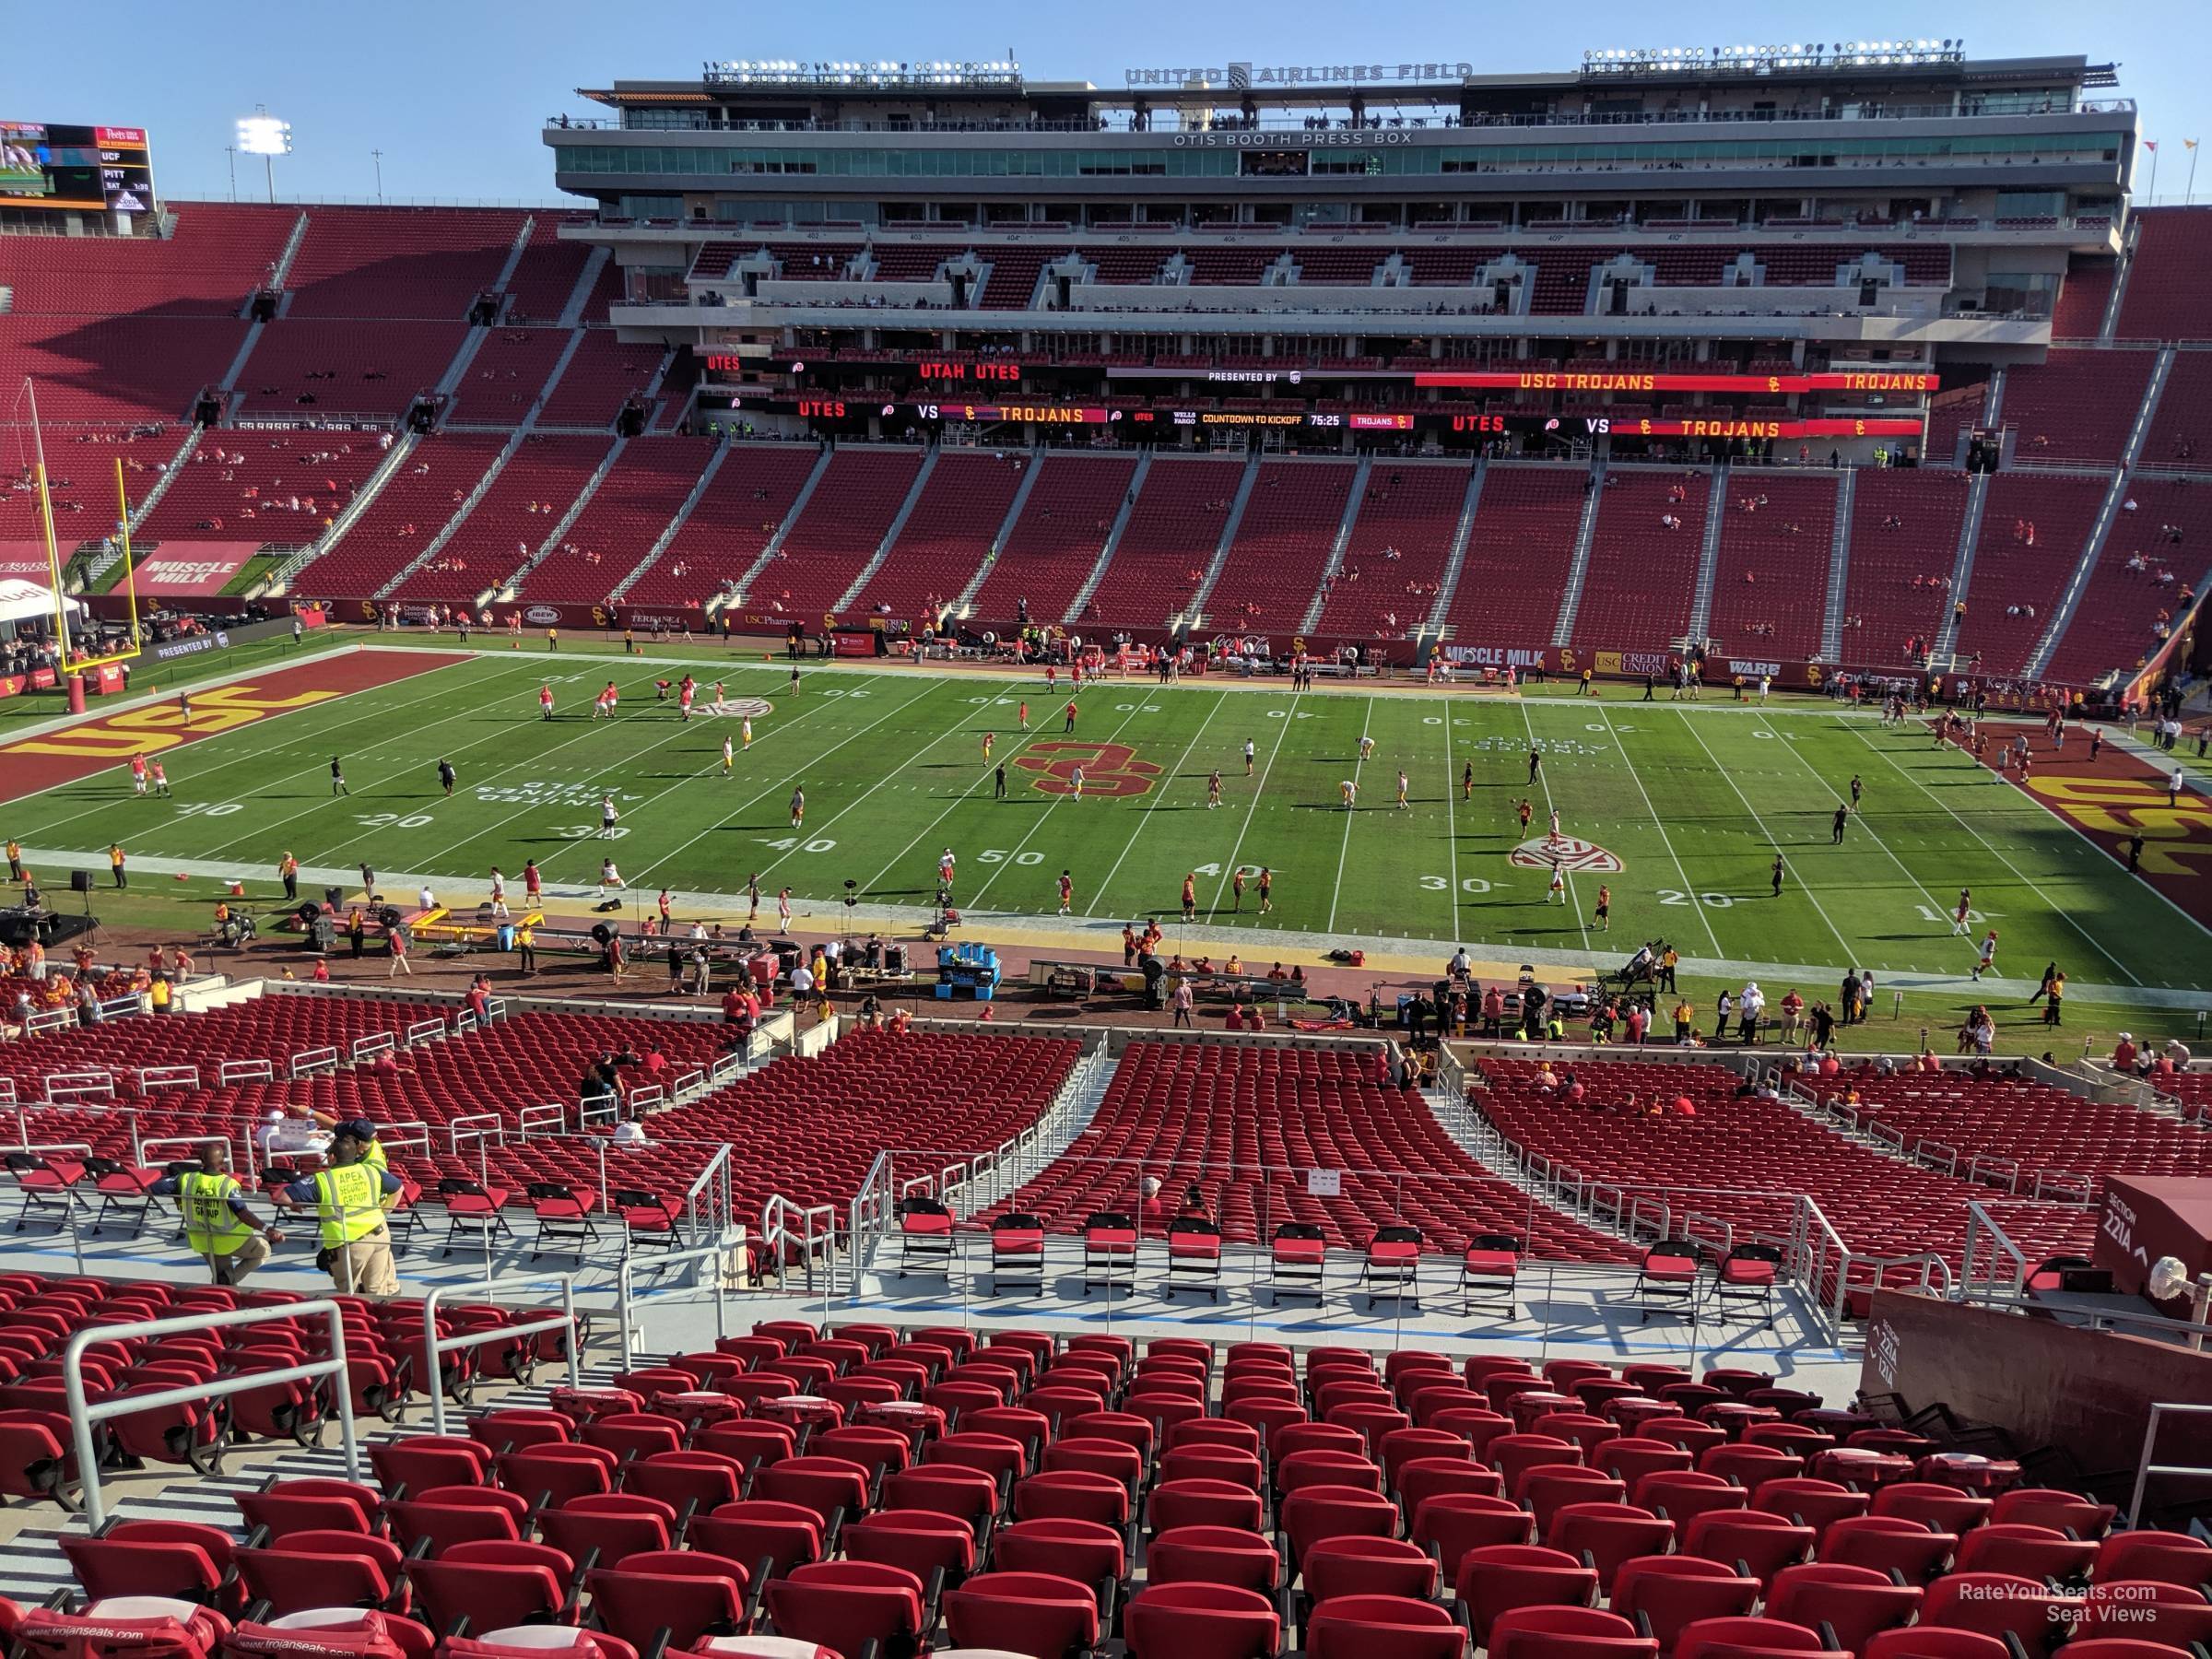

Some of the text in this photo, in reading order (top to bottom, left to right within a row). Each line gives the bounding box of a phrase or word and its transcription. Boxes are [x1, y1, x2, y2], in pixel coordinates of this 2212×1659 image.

[1125, 63, 1473, 84] UNITED AIRLINES FIELD
[1173, 132, 1412, 146] OTIS BOOTH PRESS BOX
[101, 152, 120, 160] UCF
[104, 170, 124, 179] PITT
[708, 356, 739, 370] UTES
[921, 363, 1020, 380] UTAH UTES
[1208, 372, 1277, 382] PRESENTED BY
[1521, 373, 1654, 390] USC TROJANS
[1844, 374, 1926, 390] TROJANS
[799, 402, 845, 418] UTES
[918, 405, 938, 418] VS
[1000, 406, 1084, 423] TROJANS
[1135, 413, 1154, 421] UTES
[1202, 414, 1339, 426] COUNTDOWN TO KICKOFF 75:25
[1357, 417, 1393, 426] TROJANS
[1453, 416, 1504, 432] UTES
[1586, 418, 1610, 433] VS
[1682, 420, 1780, 438] TROJANS
[146, 560, 239, 573] MUSCLE
[149, 572, 211, 584] MILK
[159, 641, 200, 658] PRESENTED
[201, 638, 213, 651] BY
[1445, 646, 1543, 666] MUSCLE MILK
[1596, 653, 1669, 668] USC CREDIT
[1622, 663, 1665, 674] UNION
[1728, 661, 1782, 677] WARE
[0, 687, 343, 758] USC
[179, 802, 244, 816] 10
[360, 813, 434, 828] 20
[765, 837, 837, 853] 40
[977, 849, 1046, 865] 50
[1194, 863, 1262, 879] 40
[1419, 876, 1492, 893] 30
[1657, 889, 1735, 908] 20
[339, 1171, 364, 1183] APEX
[339, 1182, 367, 1195] SECURITY
[343, 1193, 368, 1206] GROUP
[2109, 1192, 2136, 1226] SECTION
[2103, 1208, 2131, 1253] 221A
[1880, 1331, 1897, 1367] 221A
[1878, 1356, 1893, 1390] 121A
